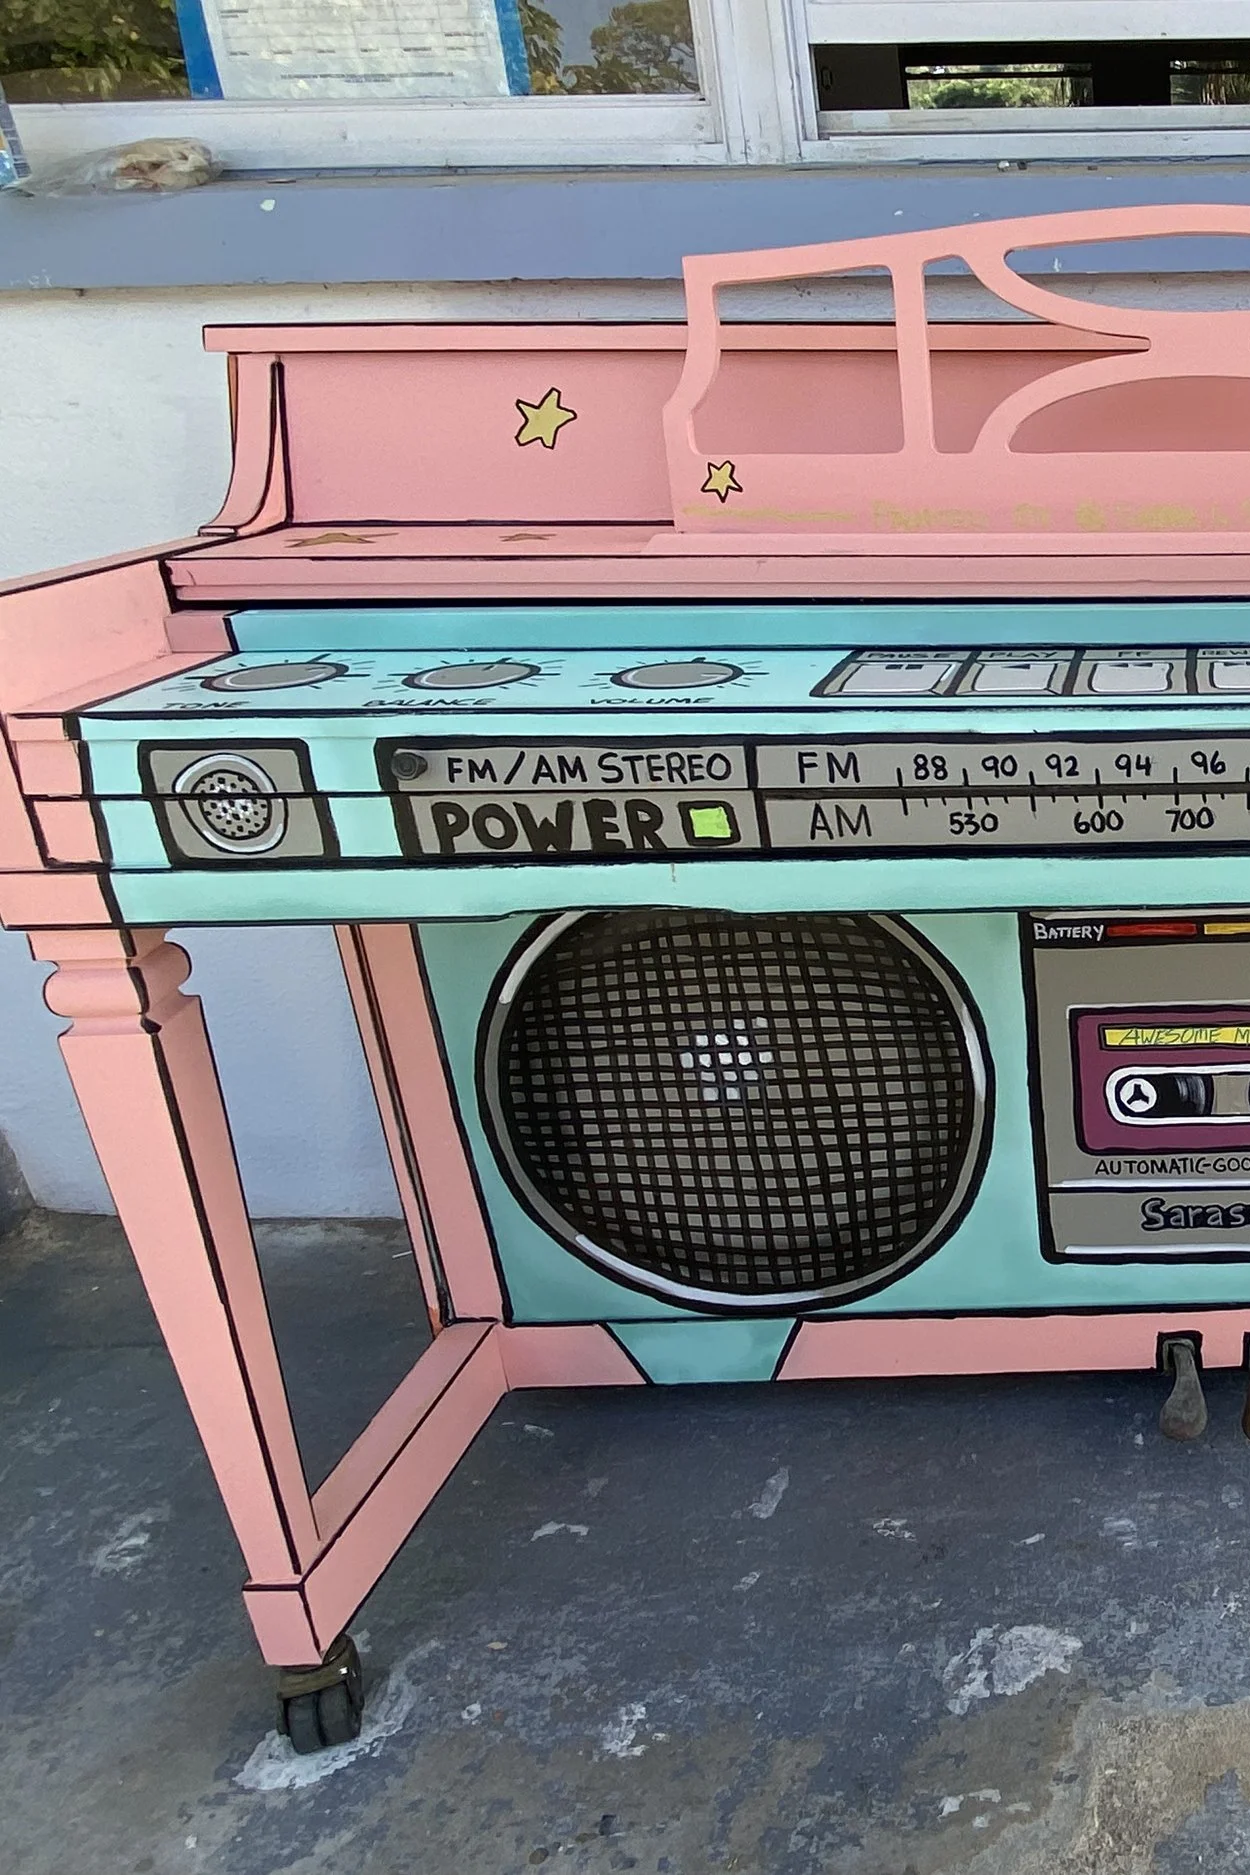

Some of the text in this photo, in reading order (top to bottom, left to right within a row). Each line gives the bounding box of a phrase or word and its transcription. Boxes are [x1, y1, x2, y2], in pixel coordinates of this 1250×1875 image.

[866, 651, 954, 660] PAUSE
[988, 651, 1058, 660] PLAY
[161, 700, 251, 710] TONE
[362, 697, 497, 708] BALANCE
[587, 696, 716, 706] VOLUME
[597, 751, 733, 785] STEREO
[797, 751, 861, 784] FM
[913, 753, 949, 781] 88
[981, 754, 1018, 778] 90
[1045, 753, 1080, 778] 92
[1114, 753, 1151, 778] 94
[1190, 750, 1227, 775] 96
[430, 798, 669, 853] POWER
[810, 802, 872, 841] AM
[949, 811, 999, 836] 530
[1073, 809, 1125, 834] 600
[1165, 807, 1216, 833] 700
[1118, 1026, 1222, 1046] AWESOME
